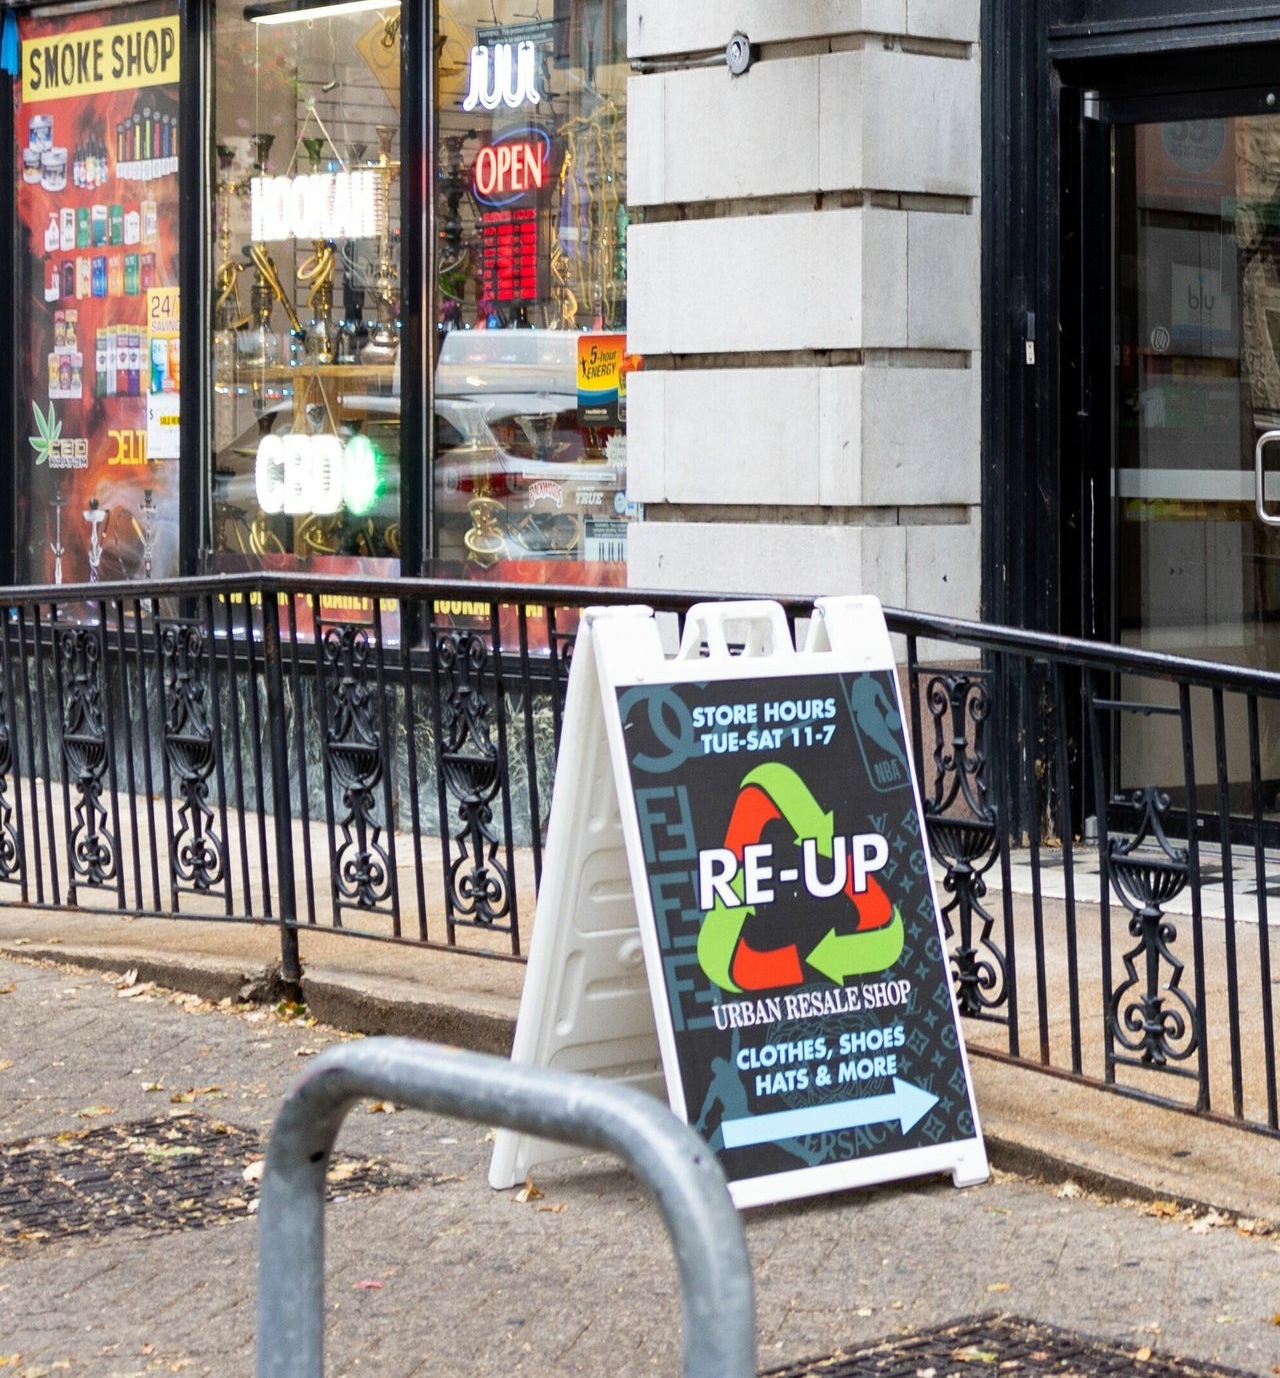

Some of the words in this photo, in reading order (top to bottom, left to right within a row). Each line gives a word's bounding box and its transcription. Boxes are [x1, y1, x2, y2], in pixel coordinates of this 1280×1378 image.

[30, 39, 104, 92] SMOKE
[111, 27, 175, 79] SHOP
[475, 141, 543, 196] OPEN
[151, 295, 181, 320] 24/
[590, 344, 618, 366] 5-hour
[587, 362, 618, 381] ENERGY
[575, 491, 605, 506] TRUE
[692, 702, 759, 728] STORE
[763, 698, 837, 723] HOURS
[700, 730, 783, 755] TUE-SAT
[790, 725, 836, 749] 11-7
[873, 758, 903, 785] NBA
[698, 832, 891, 912] RE-UP
[712, 1000, 782, 1031] URBAN
[784, 990, 861, 1023] RESALE
[861, 980, 912, 1014] SHOP
[736, 1040, 834, 1072] CLOTHES,
[839, 1025, 906, 1058] SHOES
[755, 1066, 810, 1097] HATS
[815, 1064, 832, 1089] &
[837, 1055, 898, 1083] MORE
